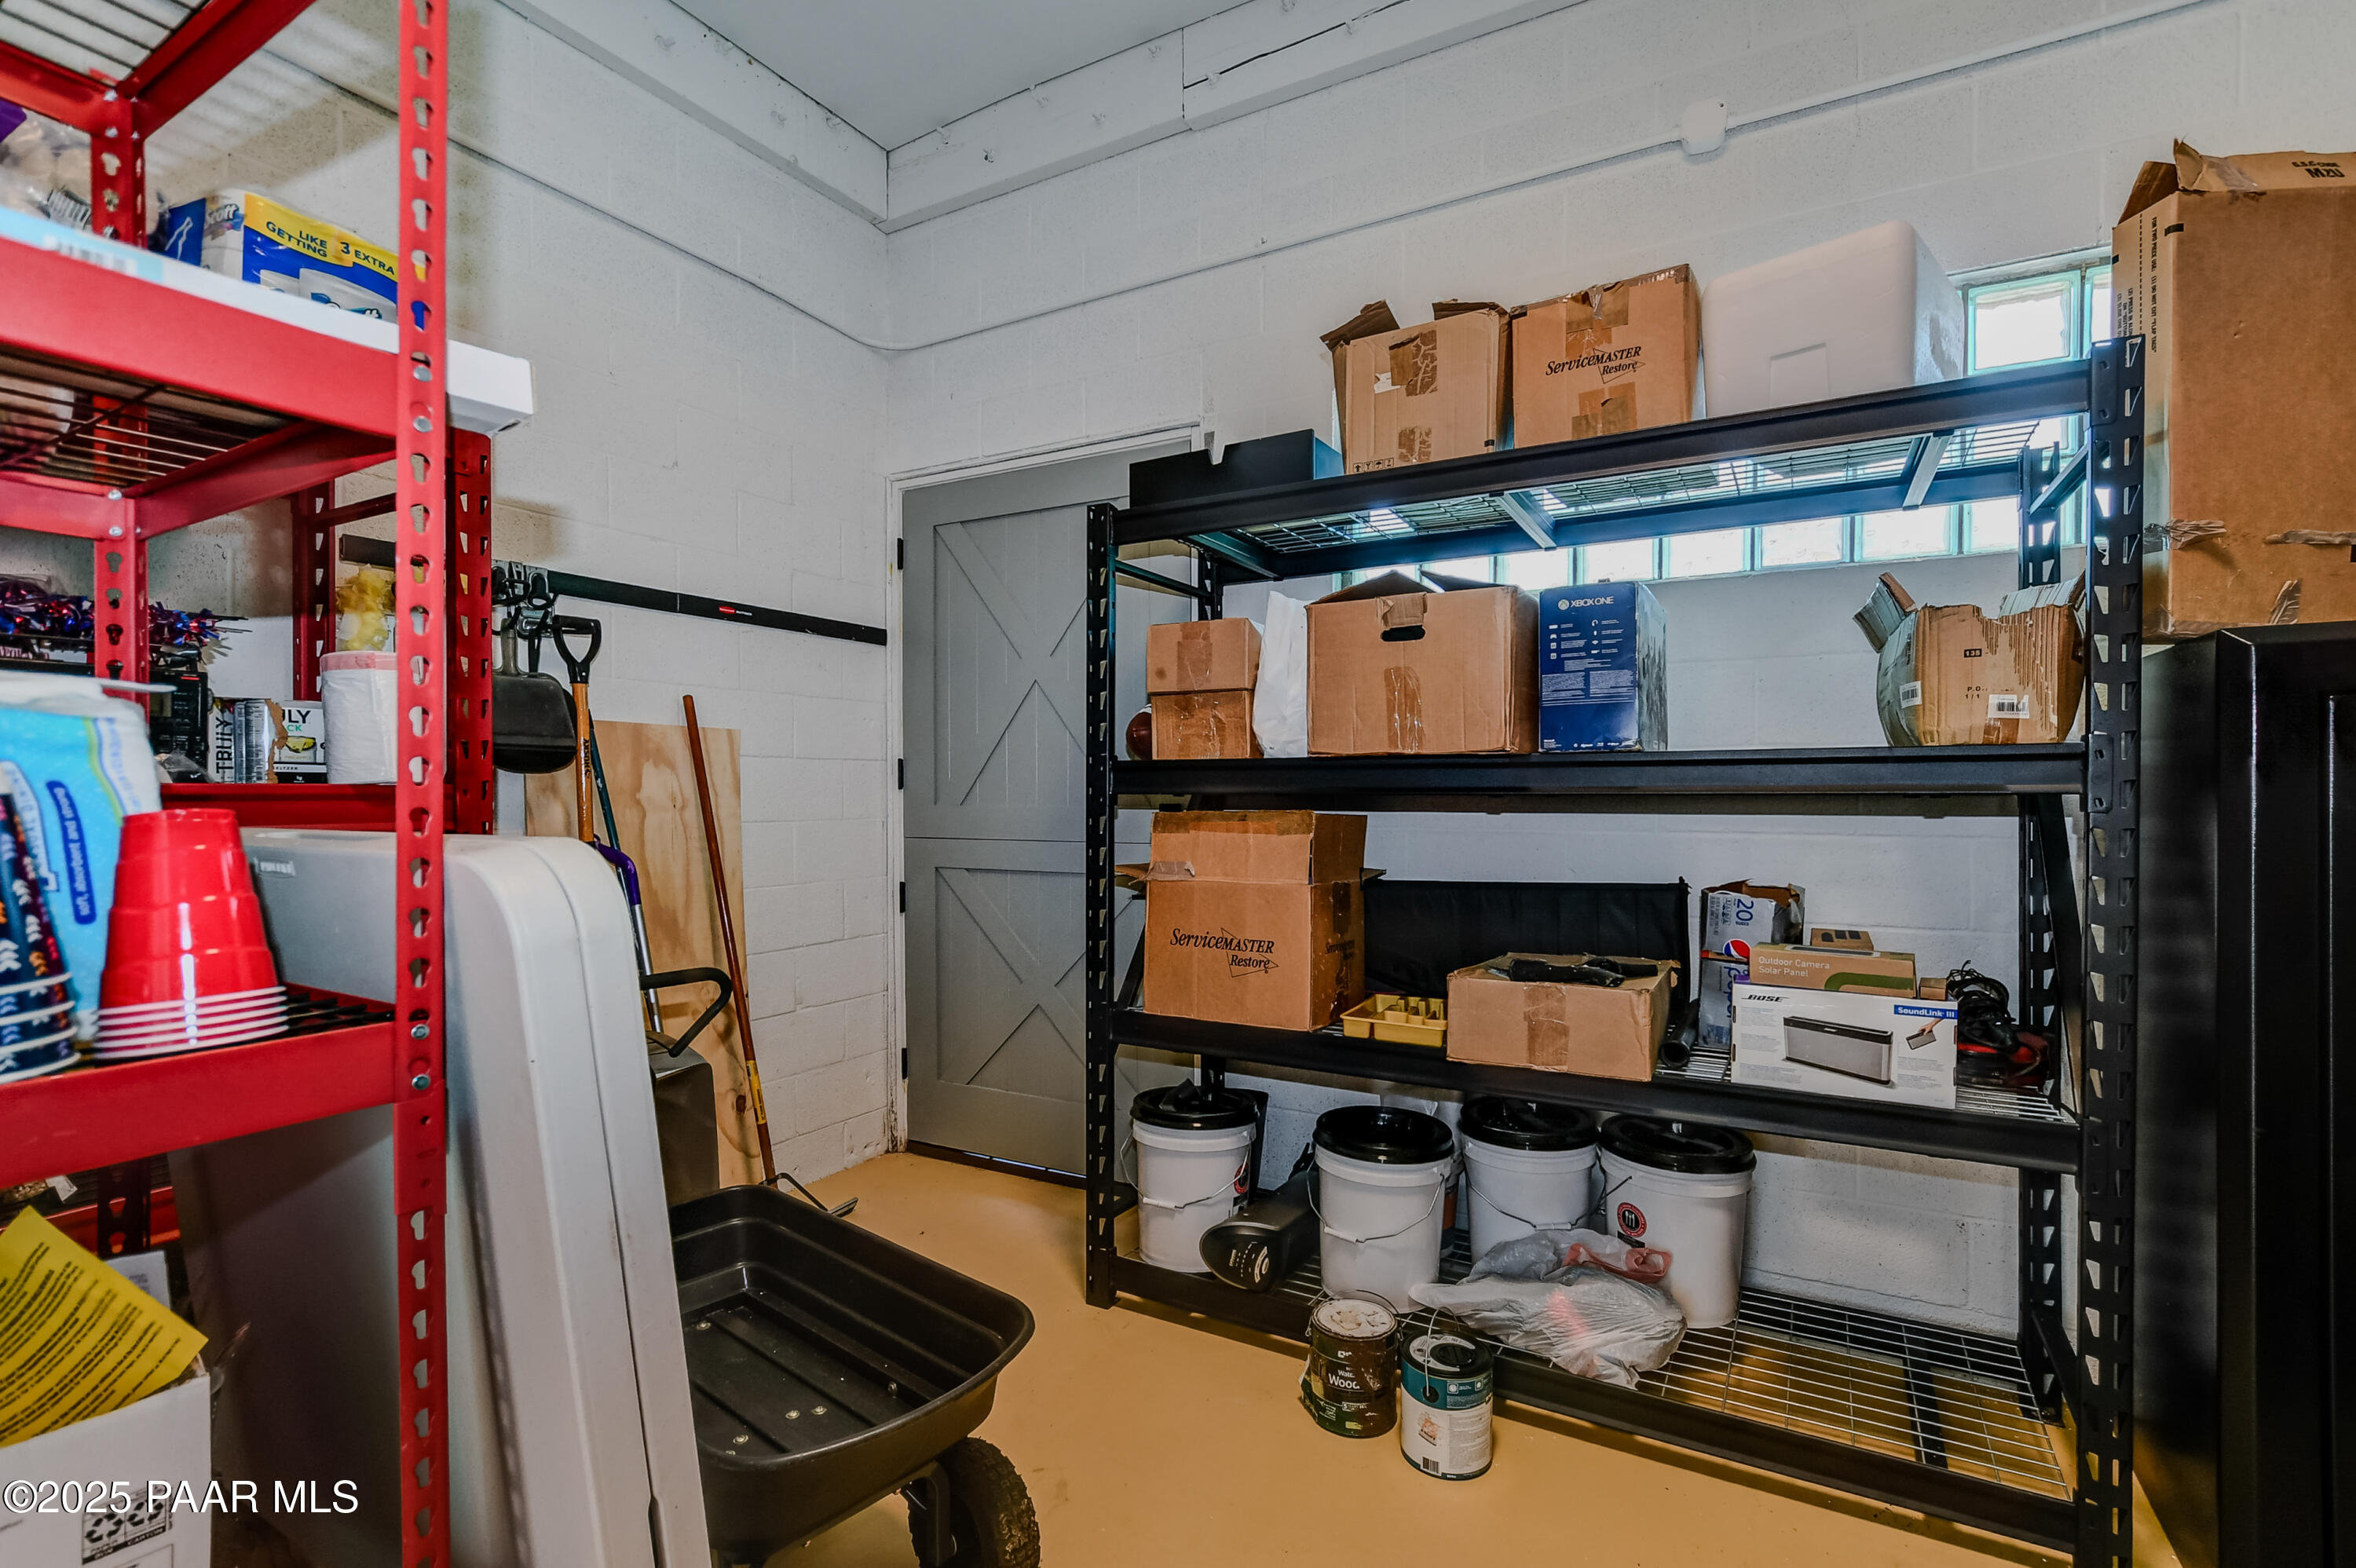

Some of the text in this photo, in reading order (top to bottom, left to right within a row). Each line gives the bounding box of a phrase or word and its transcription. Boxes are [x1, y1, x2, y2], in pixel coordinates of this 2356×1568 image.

[266, 221, 327, 258] GETTING
[299, 230, 327, 250] LIKE
[340, 240, 396, 276] 3 EXTRA
[1546, 346, 1641, 376] ServiceMASTER
[1602, 360, 1637, 375] Restore
[1571, 596, 1614, 609] XBOX ONE
[1736, 898, 1754, 922] 20
[1170, 928, 1275, 954] ServiceMASTER
[1230, 954, 1271, 970] Restore
[1758, 956, 1830, 970] Outdoor Camera
[1758, 966, 1809, 978] Solar Panel
[1747, 994, 1785, 1003] BOSE
[1897, 1006, 1942, 1018] SoundLink
